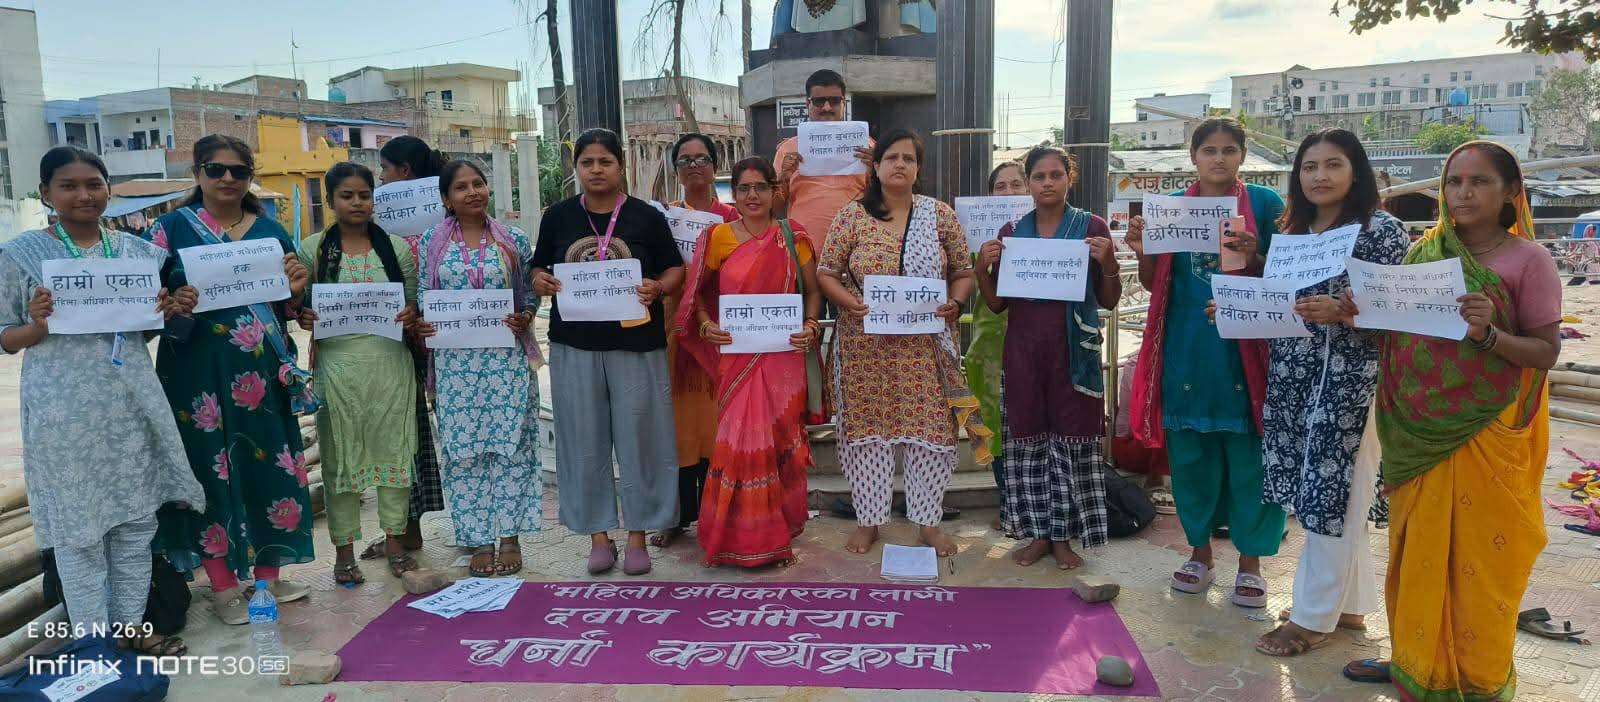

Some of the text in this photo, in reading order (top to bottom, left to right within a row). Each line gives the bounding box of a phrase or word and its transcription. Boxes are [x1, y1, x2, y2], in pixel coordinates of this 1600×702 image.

[105, 274, 153, 291] एकता
[870, 286, 941, 303] मेरो शरीर
[428, 298, 510, 312] महिला अधिकार
[761, 306, 798, 320] एकता
[697, 603, 904, 628] अभियान
